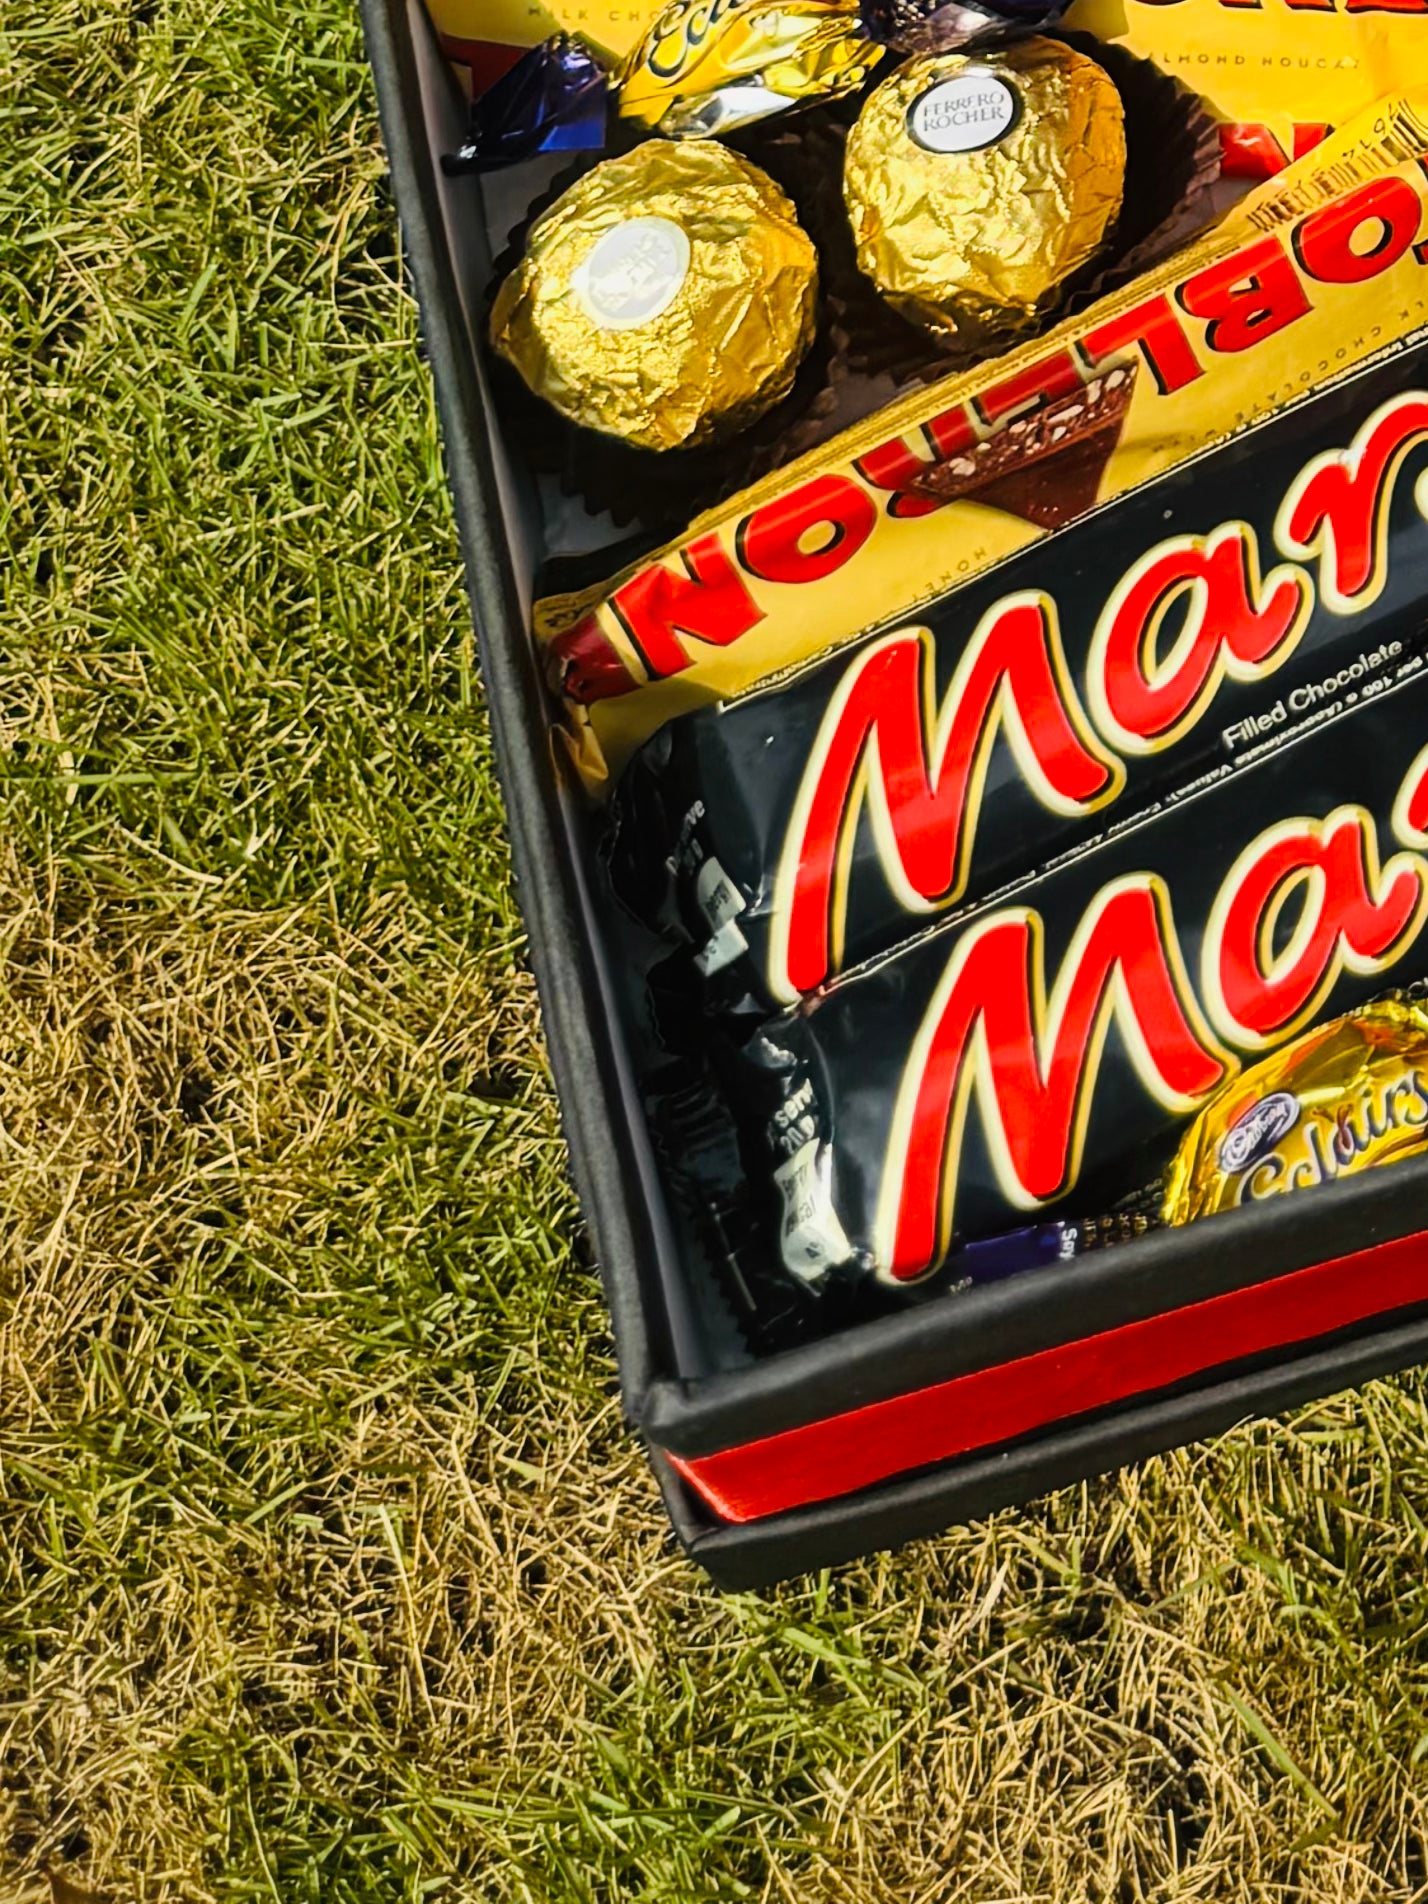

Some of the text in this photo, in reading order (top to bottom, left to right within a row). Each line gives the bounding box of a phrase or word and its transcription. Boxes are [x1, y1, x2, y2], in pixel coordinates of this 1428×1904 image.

[920, 90, 1006, 120] FERRERO
[921, 103, 1005, 134] ROCHER
[1222, 636, 1404, 751] Filled Chocolate
